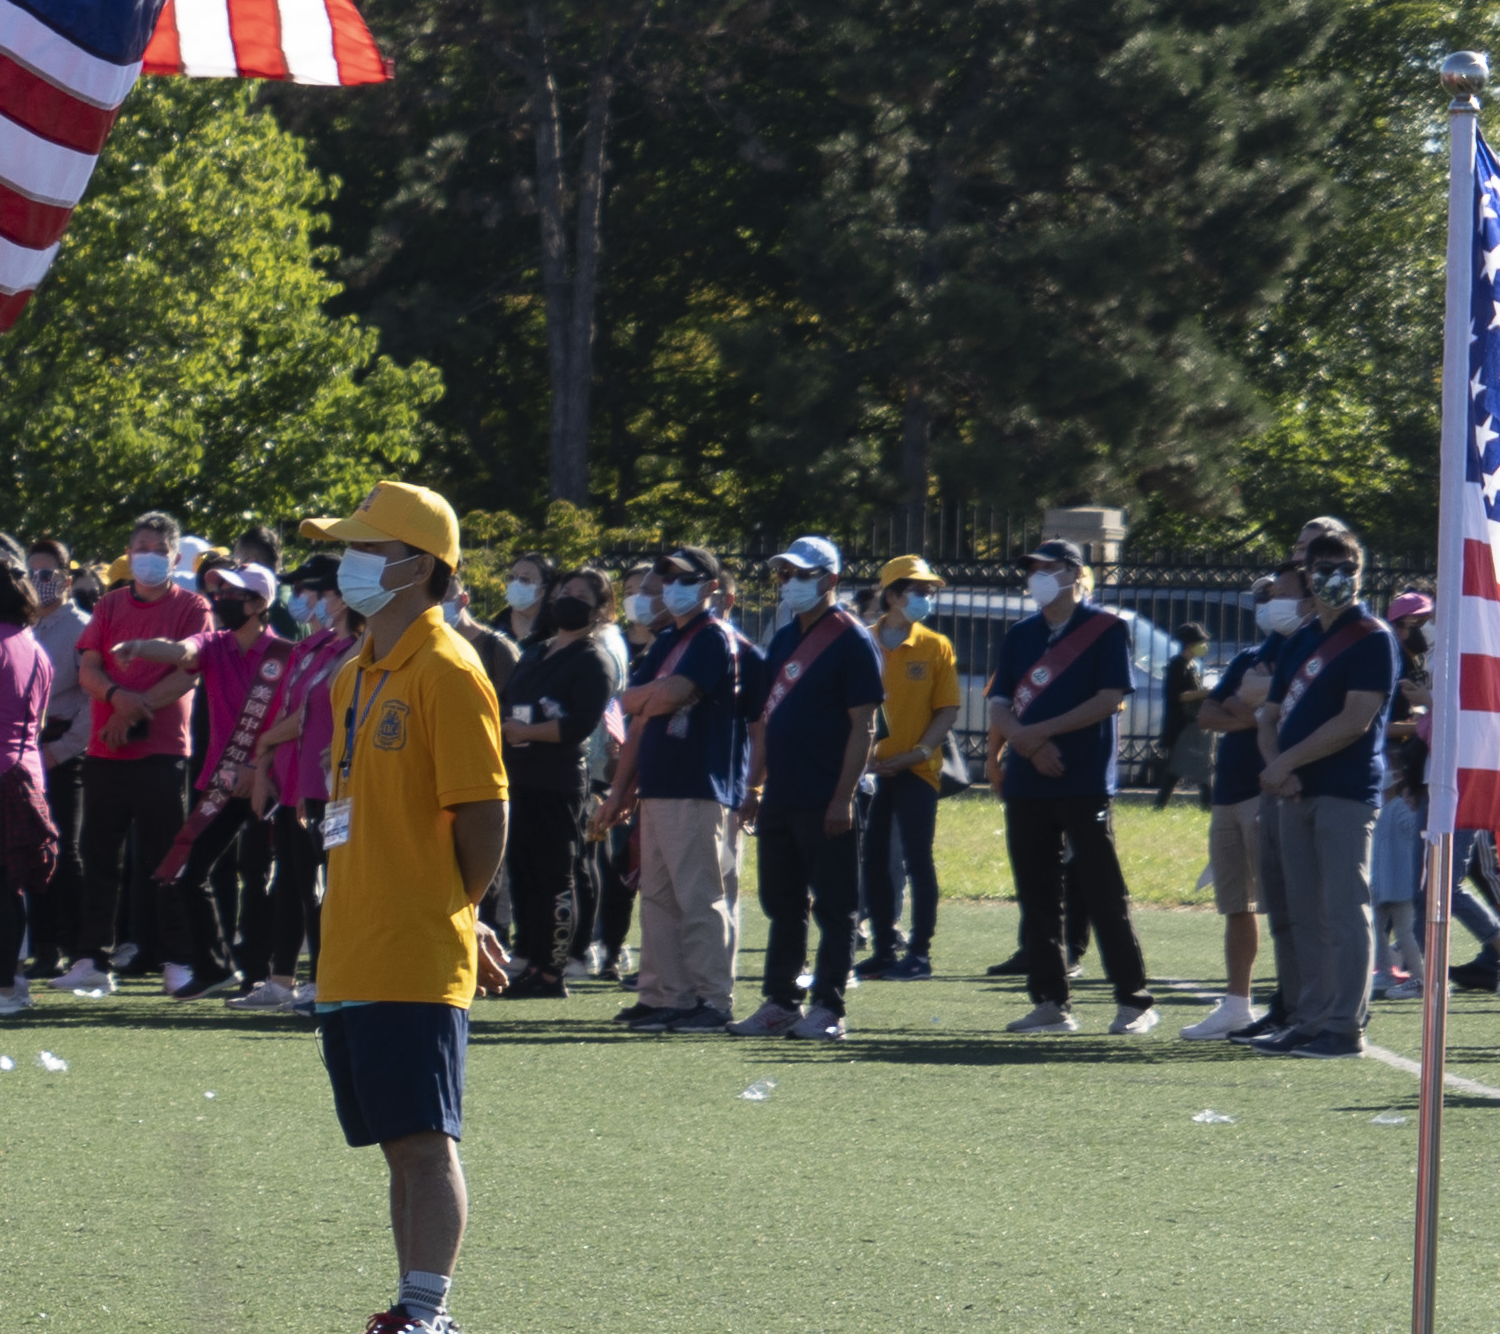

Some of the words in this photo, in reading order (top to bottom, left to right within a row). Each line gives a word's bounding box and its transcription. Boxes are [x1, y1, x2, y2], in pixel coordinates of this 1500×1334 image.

[200, 684, 274, 817] 美國中華知合會
